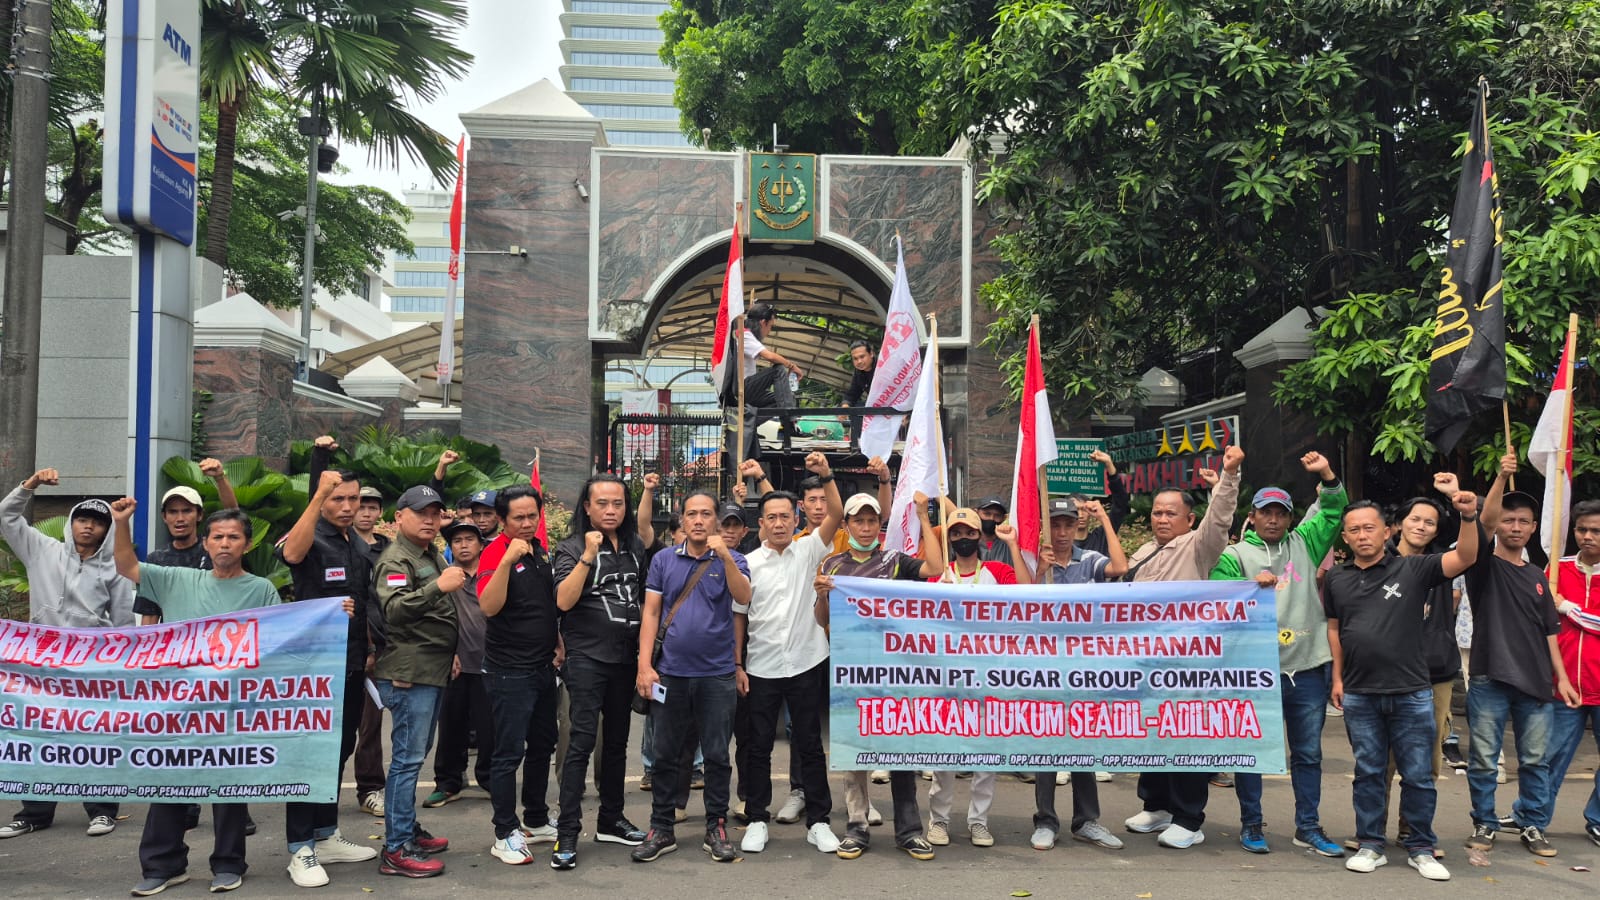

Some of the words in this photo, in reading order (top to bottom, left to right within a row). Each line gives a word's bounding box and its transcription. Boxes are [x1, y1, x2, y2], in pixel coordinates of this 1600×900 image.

[163, 22, 192, 66] ATM
[848, 597, 953, 620] "SEGERA
[962, 600, 1093, 623] TETAPKAN
[1101, 600, 1258, 623] TERSANGKA"
[96, 633, 131, 664] &
[124, 617, 260, 670] PERIKSA
[885, 632, 937, 654] DAN
[944, 634, 1057, 656] LAKUKAN
[1066, 635, 1222, 657] PENAHANAN
[240, 676, 332, 700] PAJAK
[835, 667, 942, 686] PIMPINAN
[948, 668, 981, 687] PT.
[987, 668, 1060, 689] SUGAR
[1068, 670, 1143, 689] GROUP
[1149, 669, 1274, 689] COMPANIES
[0, 704, 15, 727] &
[24, 705, 226, 734] PENCAPLOKAN
[235, 708, 332, 732] LAHAN
[857, 696, 983, 737] TEGAKKAN
[984, 699, 1065, 738] HUKUM
[1069, 698, 1263, 739] SEADIL-ADILNYA
[0, 741, 33, 762] AR
[40, 744, 123, 767] GROUP
[130, 746, 276, 767] COMPANIES
[857, 753, 877, 764] ATAS
[878, 753, 903, 764] NAMA
[905, 753, 960, 765] MASYARAKAT
[960, 754, 1000, 765] LAMPUNG
[1010, 754, 1027, 765] DPP
[1029, 754, 1051, 766] AKAR
[1053, 755, 1094, 766] LAMPUNG
[1102, 755, 1120, 766] DPP
[1121, 755, 1166, 767] PEMATANK
[1173, 755, 1213, 767] KERAMAT
[1214, 755, 1255, 767] LAMPUNG
[34, 783, 53, 795] DPP
[54, 785, 80, 796] AKAR
[82, 786, 128, 797] LAMPUNG
[138, 786, 157, 797] DPP
[159, 786, 209, 798] PEMATANK
[218, 785, 264, 797] KERAMAT
[264, 784, 310, 796] LAMPUNG
